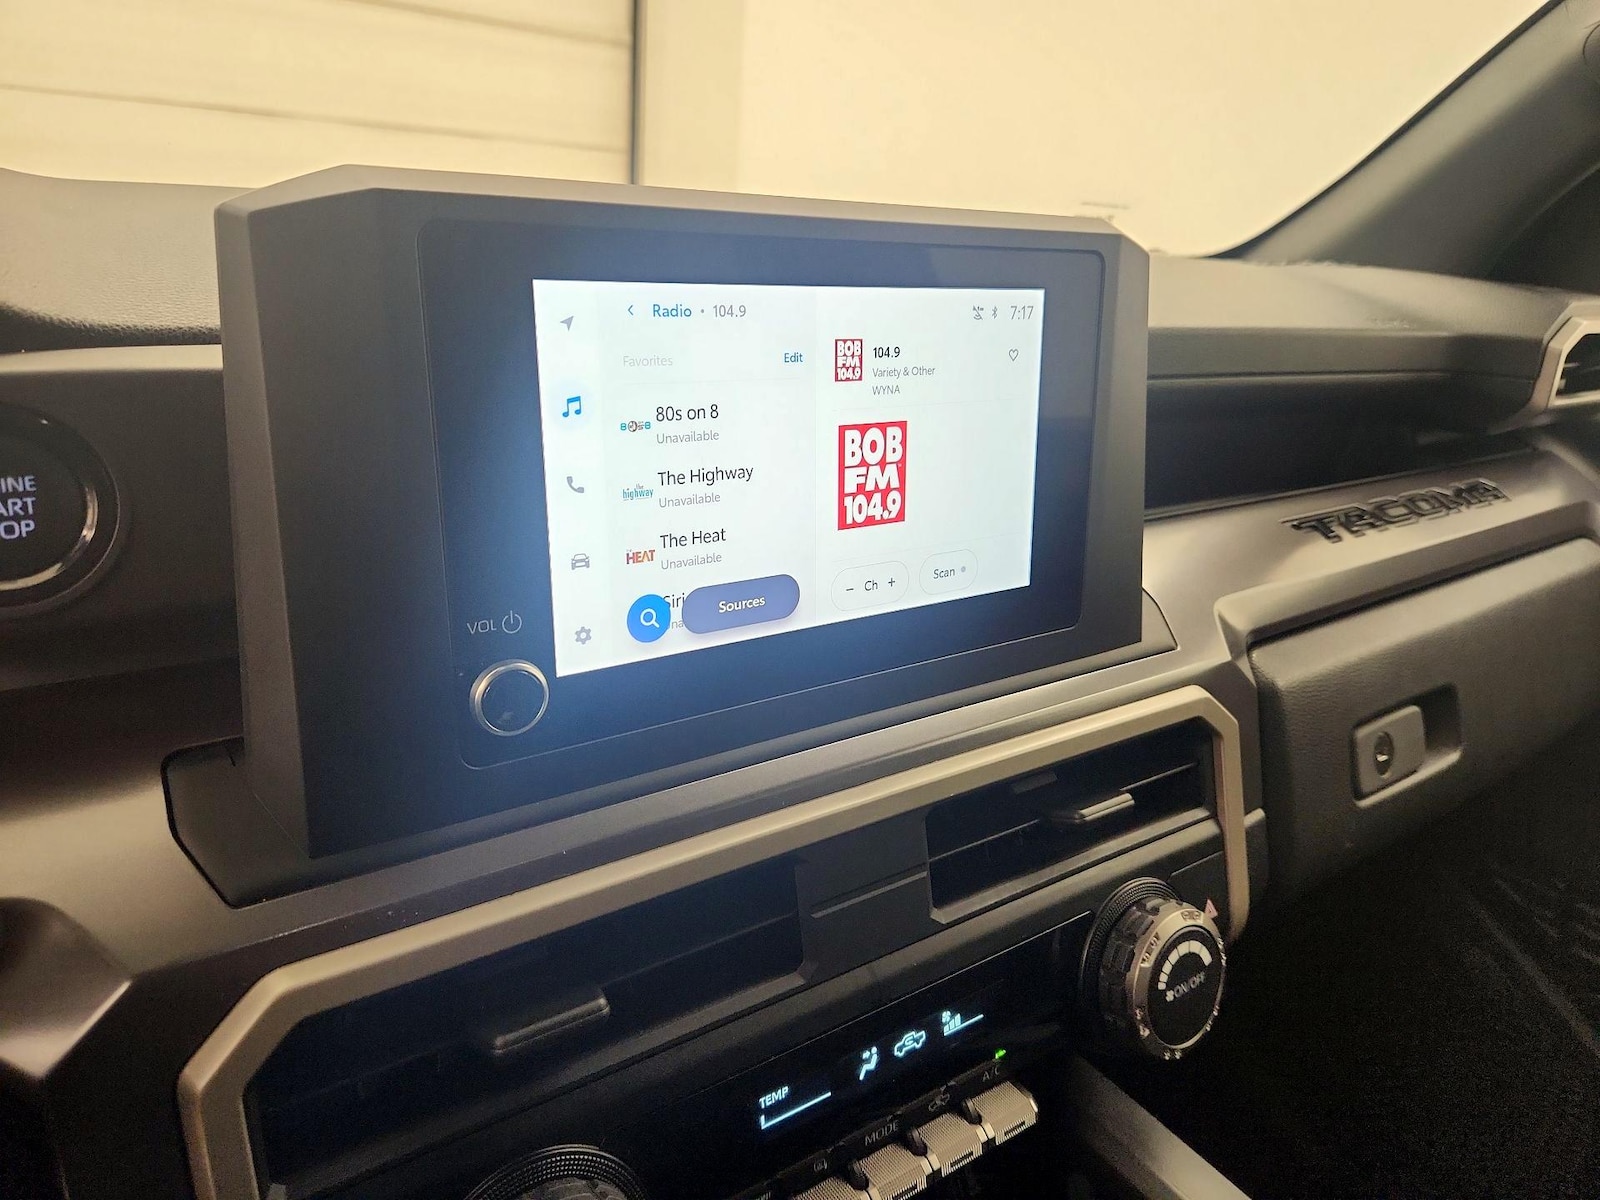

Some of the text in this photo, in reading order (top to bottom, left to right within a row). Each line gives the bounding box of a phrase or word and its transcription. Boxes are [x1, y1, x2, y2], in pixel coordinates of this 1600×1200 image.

[652, 303, 747, 318] Radio 104.9
[1010, 305, 1034, 320] 7:17
[836, 340, 862, 357] BOB
[872, 346, 901, 359] 104.9
[622, 354, 673, 367] Favorites
[783, 352, 804, 364] Edit
[837, 356, 861, 368] FM
[836, 367, 862, 381] 104.9
[872, 366, 936, 379] Variety & Other
[872, 385, 901, 396] WYNA
[655, 403, 720, 422] 80s on 8
[656, 430, 720, 445] Unavailable
[844, 426, 904, 467] BOB
[657, 465, 755, 487] The Highway
[843, 463, 901, 494] FM
[622, 487, 654, 501] highway
[659, 492, 722, 508] Unavailable
[843, 490, 902, 525] 104.9
[1279, 478, 1511, 543] TACOMA
[659, 528, 727, 549] The Heat
[626, 549, 656, 565] HEAT
[660, 552, 723, 570] Unavailable
[932, 568, 956, 580] Scan
[863, 580, 879, 591] Ch
[718, 596, 766, 613] Sources
[466, 619, 497, 635] VOL
[758, 1085, 789, 1109] TEMP
[864, 1120, 900, 1147] MODE
